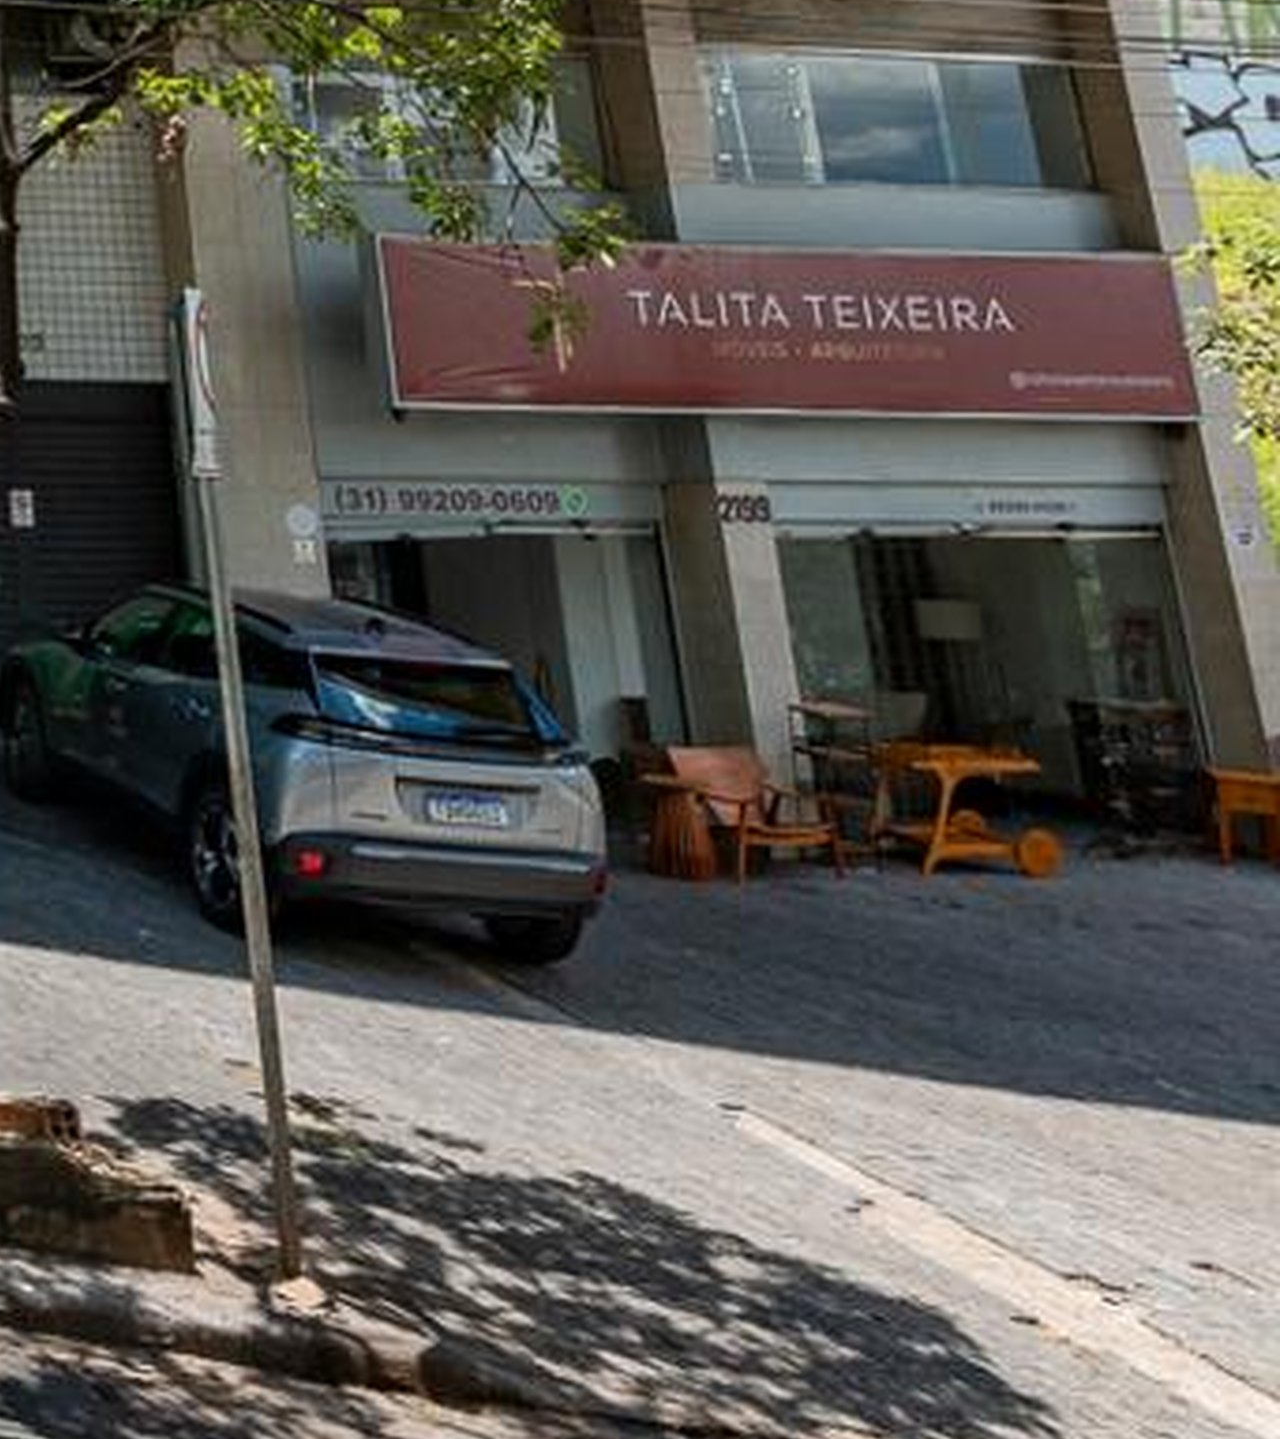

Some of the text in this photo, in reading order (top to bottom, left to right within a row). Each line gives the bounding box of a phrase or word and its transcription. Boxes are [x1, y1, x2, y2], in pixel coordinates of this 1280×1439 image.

[627, 290, 1015, 332] TALITA TEIXEIRA
[334, 485, 388, 514] (31)
